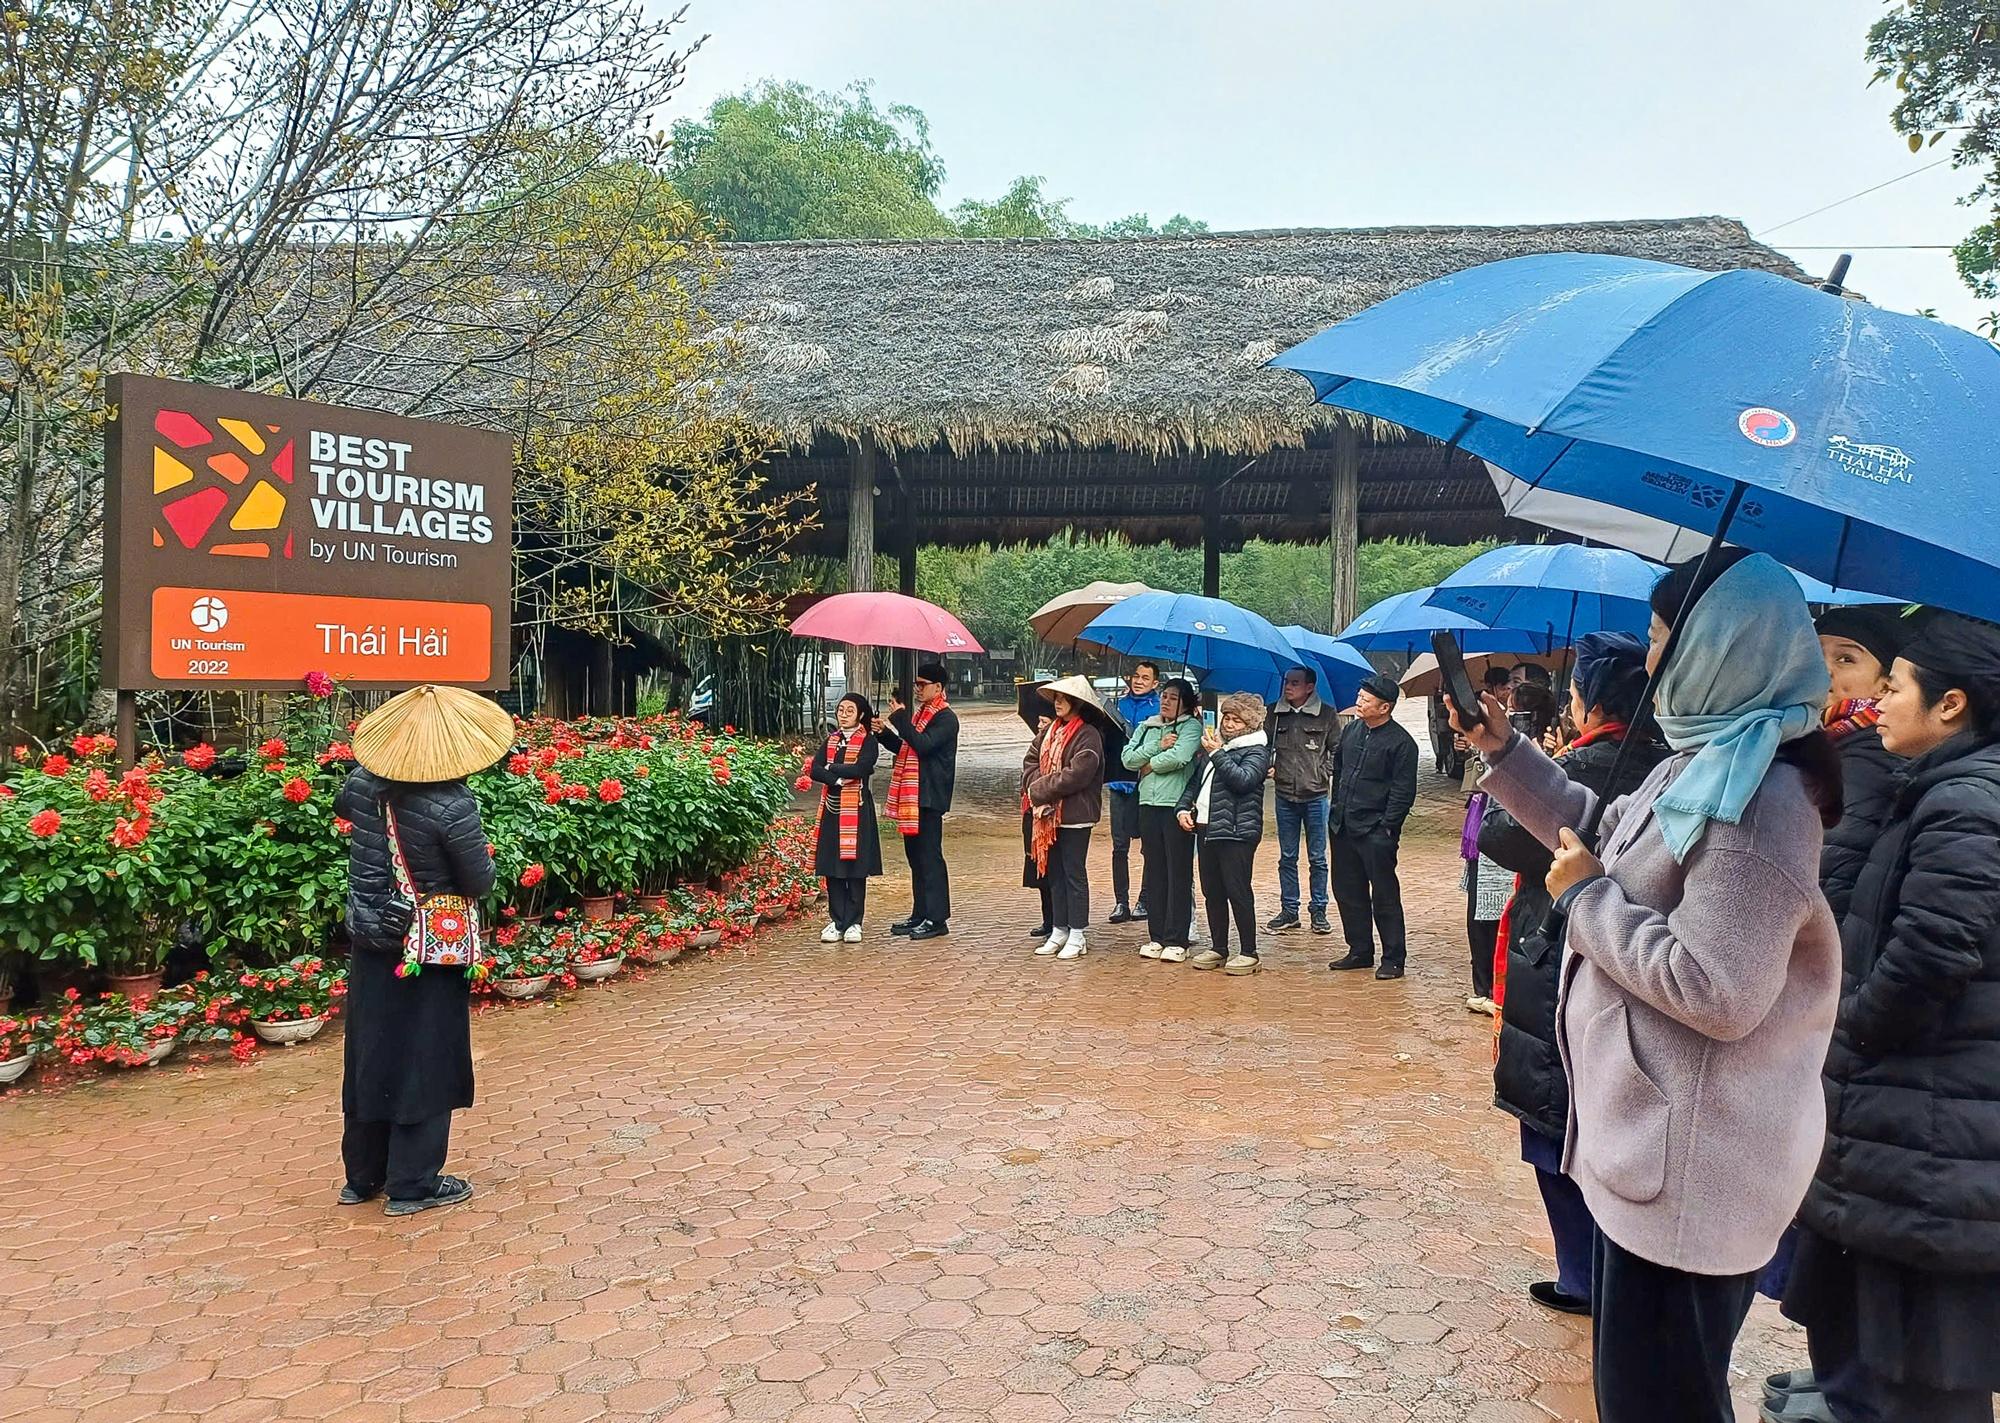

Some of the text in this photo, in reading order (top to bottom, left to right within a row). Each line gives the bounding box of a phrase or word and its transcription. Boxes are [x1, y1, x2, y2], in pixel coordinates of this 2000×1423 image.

[310, 431, 412, 472] BEST
[1826, 448, 1873, 472] THÁI
[310, 464, 484, 513] TOURISM
[1842, 463, 1890, 485] VILLAGE
[310, 497, 493, 544] VILLAGES
[310, 538, 457, 568] by UN Tourism
[170, 638, 245, 652] UN Tourism
[315, 623, 448, 657] Thái Hải
[187, 659, 229, 675] 2022
